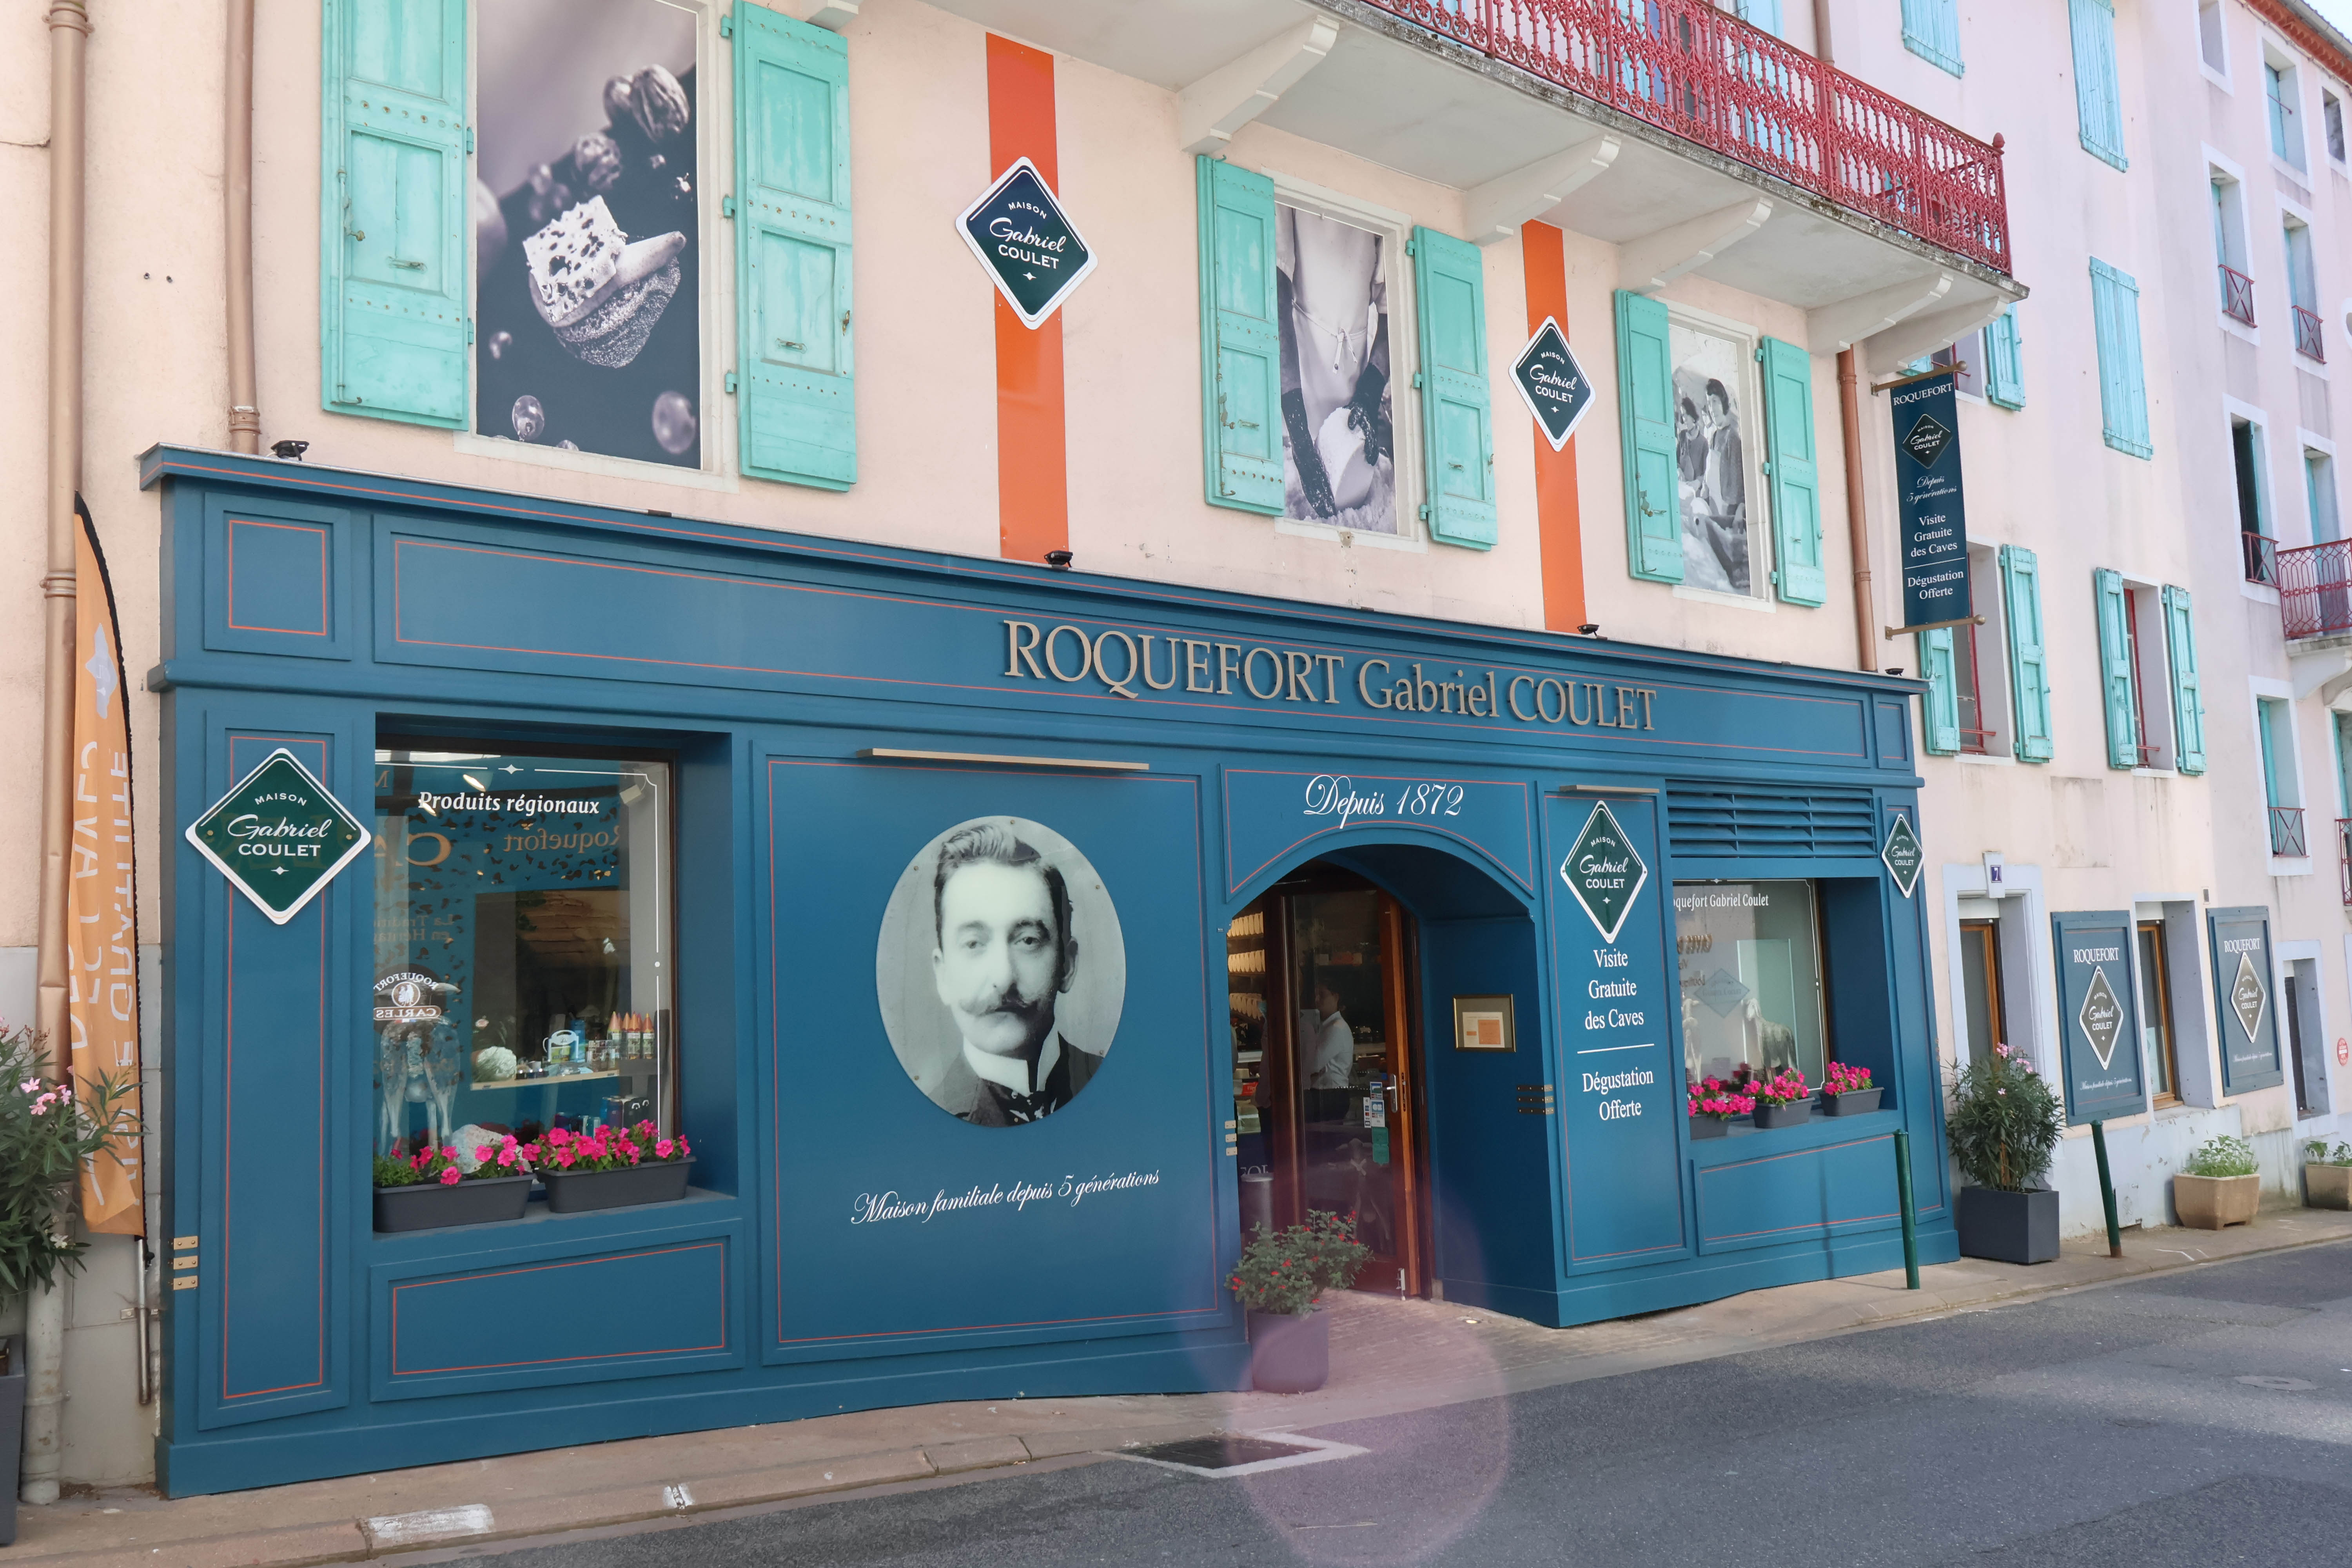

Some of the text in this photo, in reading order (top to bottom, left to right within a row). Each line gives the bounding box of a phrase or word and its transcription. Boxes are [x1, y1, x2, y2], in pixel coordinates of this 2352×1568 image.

[1008, 201, 1047, 219] MAISON
[989, 217, 1066, 253] Gabriel
[998, 244, 1059, 269] COULET
[1541, 351, 1565, 365] MAISON
[1530, 364, 1577, 390] Gabriel
[1535, 385, 1573, 403] COULET
[1893, 383, 1953, 406] ROQUEFORT
[1910, 430, 1943, 445] Gabriel
[1914, 440, 1940, 450] COULET
[1916, 475, 1945, 489] Depuis
[1913, 485, 1957, 505] générations
[1919, 514, 1946, 526] Visite
[1914, 528, 1953, 542] Gratuite
[1911, 542, 1958, 557] des Caves
[1907, 570, 1964, 588] Dégustation
[1919, 587, 1953, 600] Offerte
[1004, 619, 1656, 731] ROQUEFORT Gabriel COULET
[255, 793, 307, 806] MAISON
[418, 792, 599, 817] Produits régionaux
[1303, 775, 1464, 829] Depuis 1872
[227, 814, 332, 840] Gabriel
[238, 844, 321, 857] COULET
[1591, 837, 1616, 847] MAISON
[1891, 846, 1916, 858] Gabriel
[1579, 854, 1629, 876] Gabriel
[1994, 867, 1999, 881] 7
[1586, 878, 1625, 889] COULET
[1710, 893, 1740, 907] Gabriel
[1742, 893, 1769, 906] Coulet
[2224, 938, 2260, 954] ROQUEFORT
[1593, 948, 1628, 968] Visite
[2073, 947, 2119, 965] ROQUEFORT
[1588, 978, 1637, 999] Gratuite
[2094, 992, 2107, 1000] MAISON
[2089, 1005, 2114, 1021] Gabriel
[2241, 1001, 2257, 1009] COULET
[1585, 1009, 1644, 1030] des Caves
[2092, 1022, 2112, 1031] COULET
[1582, 1067, 1654, 1095] Dégustation
[1599, 1099, 1642, 1121] Offerte
[850, 1169, 1159, 1225] Maison familiale depuis 5 générations
